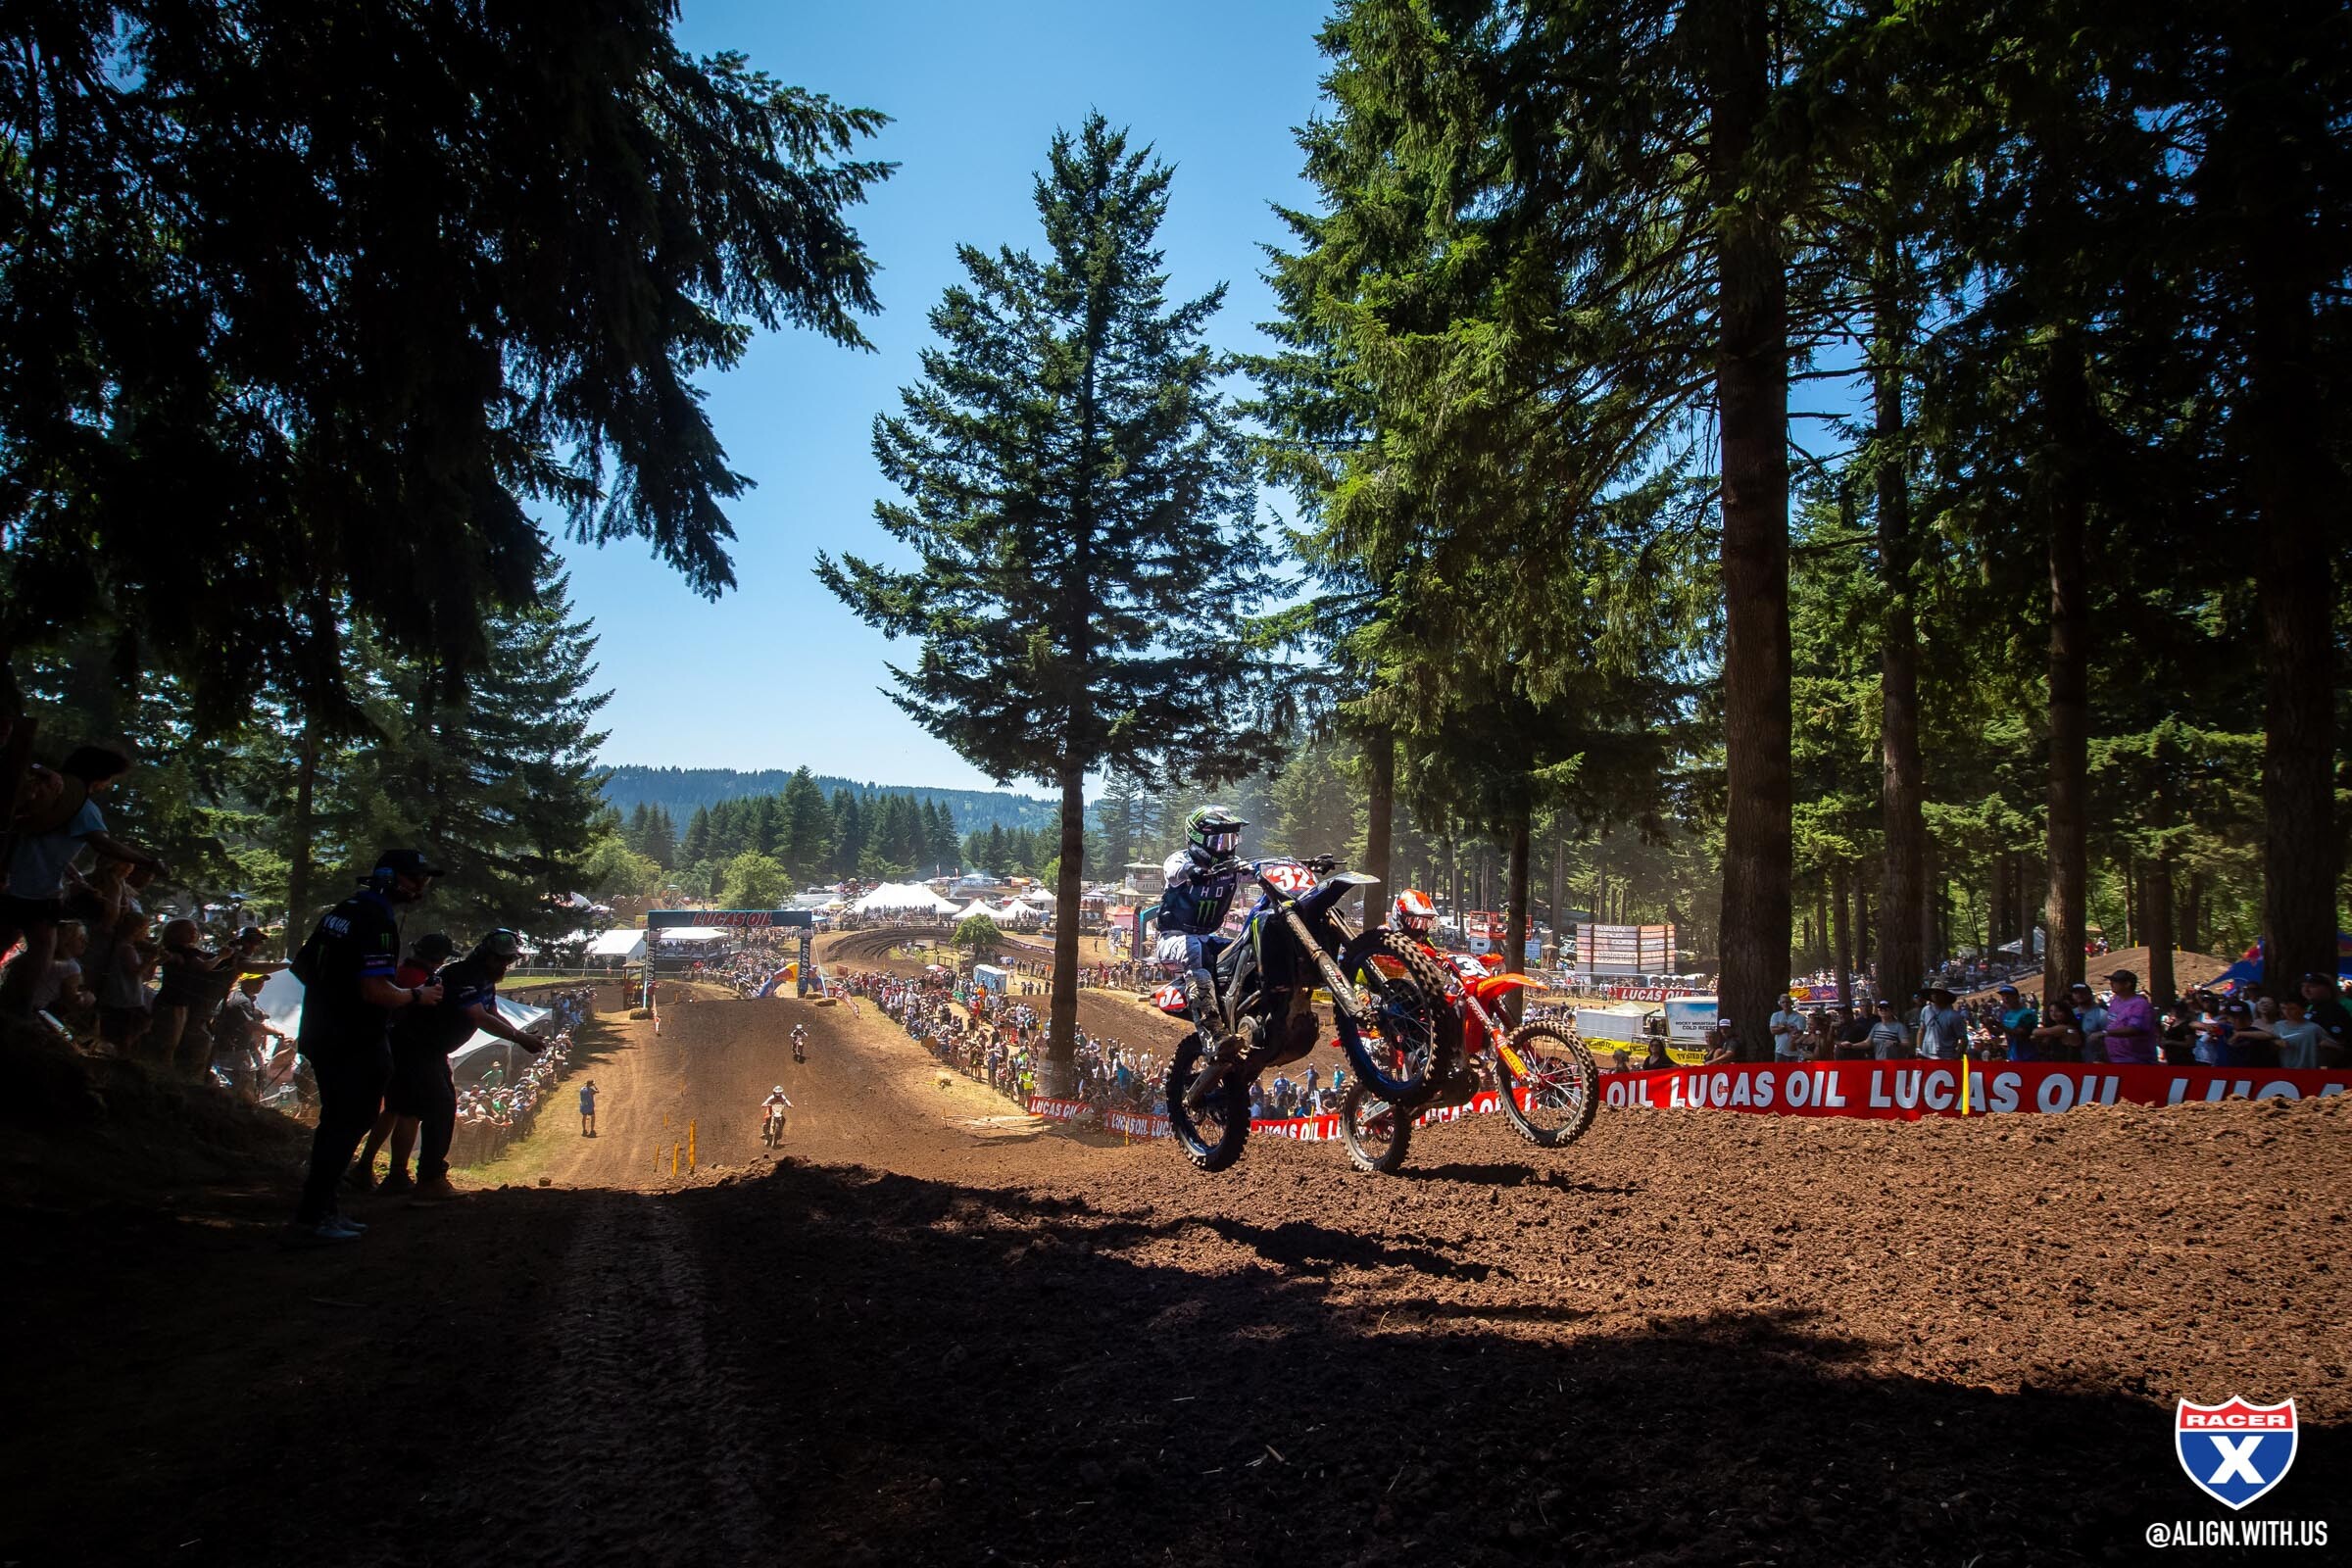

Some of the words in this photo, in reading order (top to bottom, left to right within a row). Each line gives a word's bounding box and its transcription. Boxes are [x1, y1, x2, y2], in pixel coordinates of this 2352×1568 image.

[1274, 864, 1316, 892] 32
[693, 912, 746, 926] LUCAS
[747, 912, 773, 926] OIL
[802, 943, 810, 968] LUCAS
[1621, 989, 1663, 1001] LUCAS
[1606, 1079, 1654, 1108] OIL
[1669, 1070, 1775, 1107] LUCAS
[1785, 1070, 1846, 1107] OIL
[1869, 1069, 2023, 1113] LUCAS
[1030, 1099, 1061, 1117] LUCAS
[1111, 1112, 1135, 1134] LUCAS
